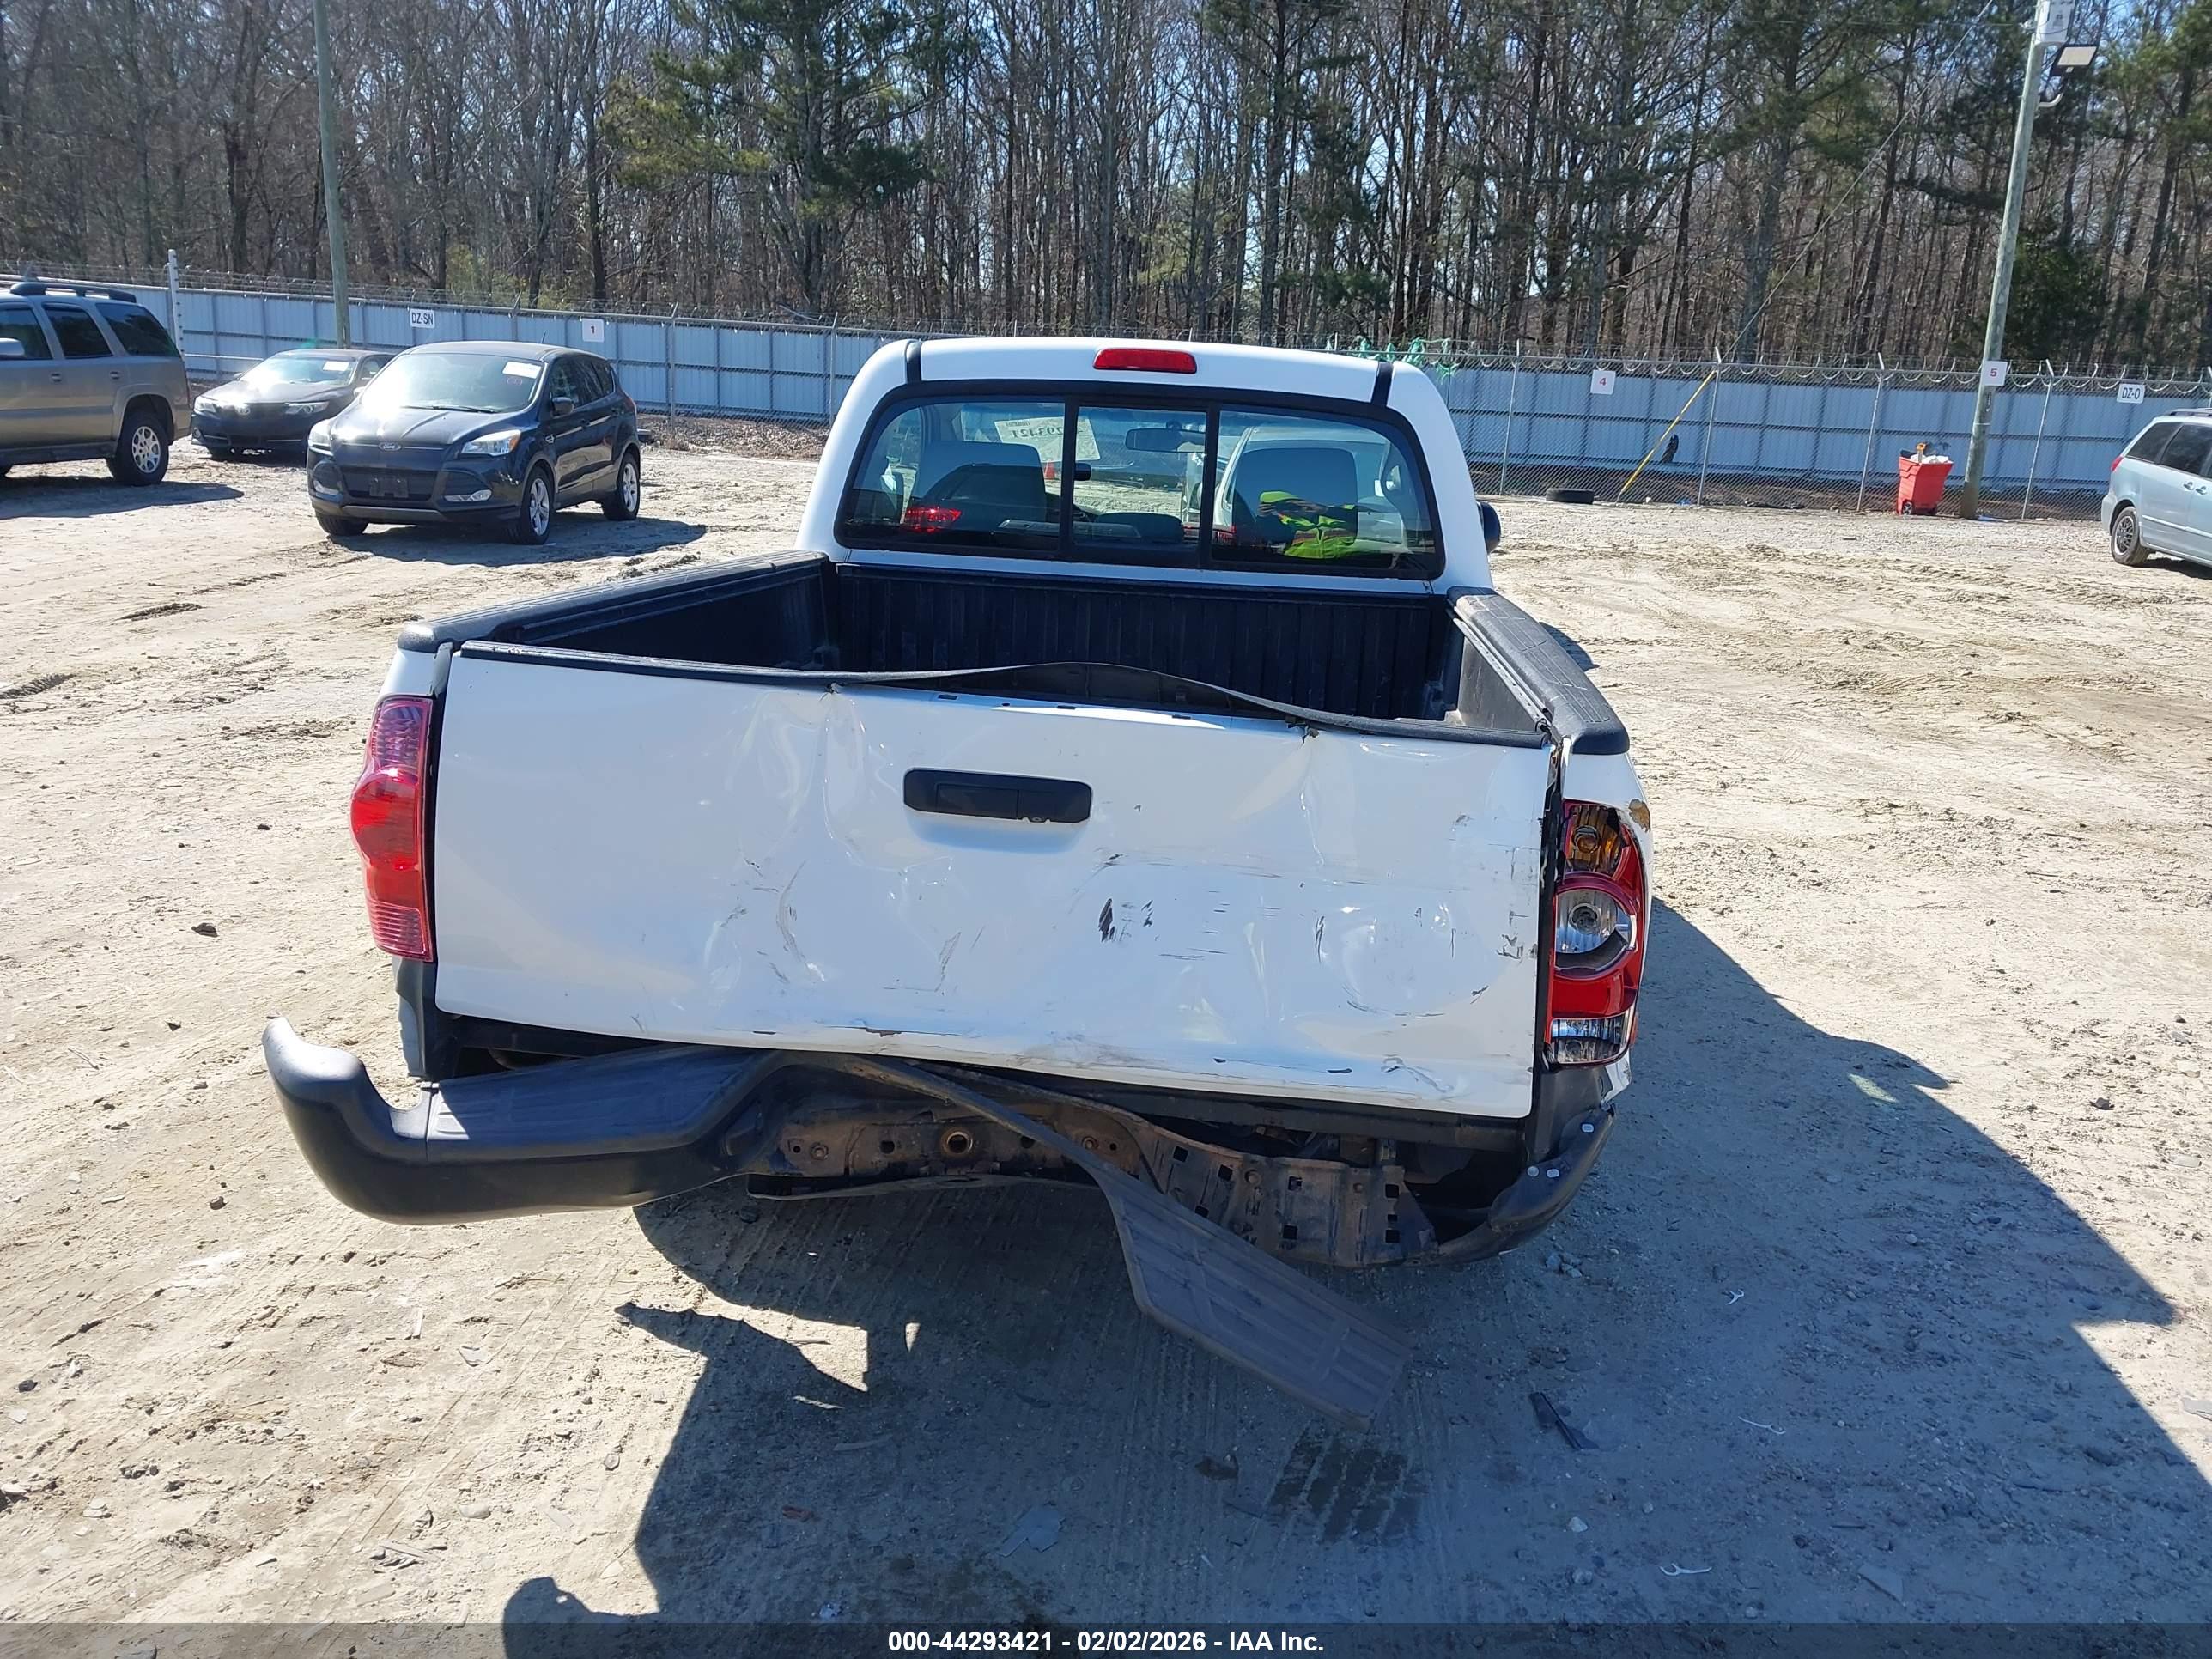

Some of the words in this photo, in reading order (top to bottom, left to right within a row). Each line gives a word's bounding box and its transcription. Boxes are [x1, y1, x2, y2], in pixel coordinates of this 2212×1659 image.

[590, 325, 595, 334] 1
[1990, 368, 1997, 377] 5
[1600, 377, 1607, 386] 4
